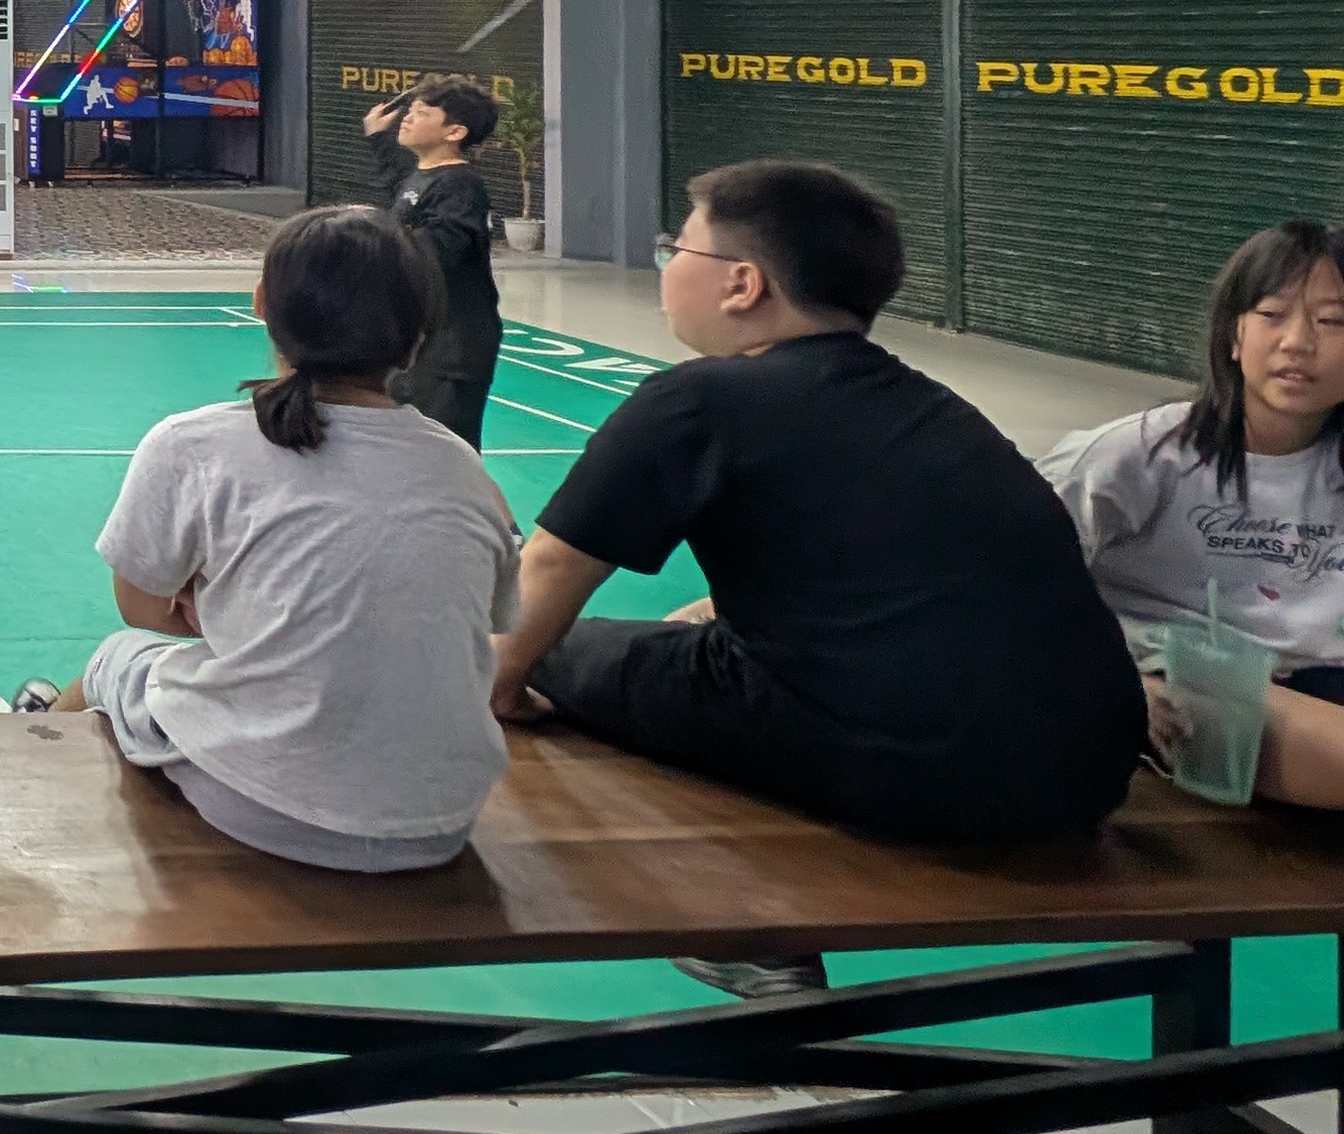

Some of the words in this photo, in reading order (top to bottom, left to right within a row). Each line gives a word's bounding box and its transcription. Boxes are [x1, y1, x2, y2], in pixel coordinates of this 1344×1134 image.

[341, 66, 515, 106] PURED
[679, 53, 928, 87] PUREGOLD
[976, 61, 1344, 107] PUREGOLD
[1207, 535, 1285, 554] SPEAKS
[1290, 543, 1311, 558] TO
